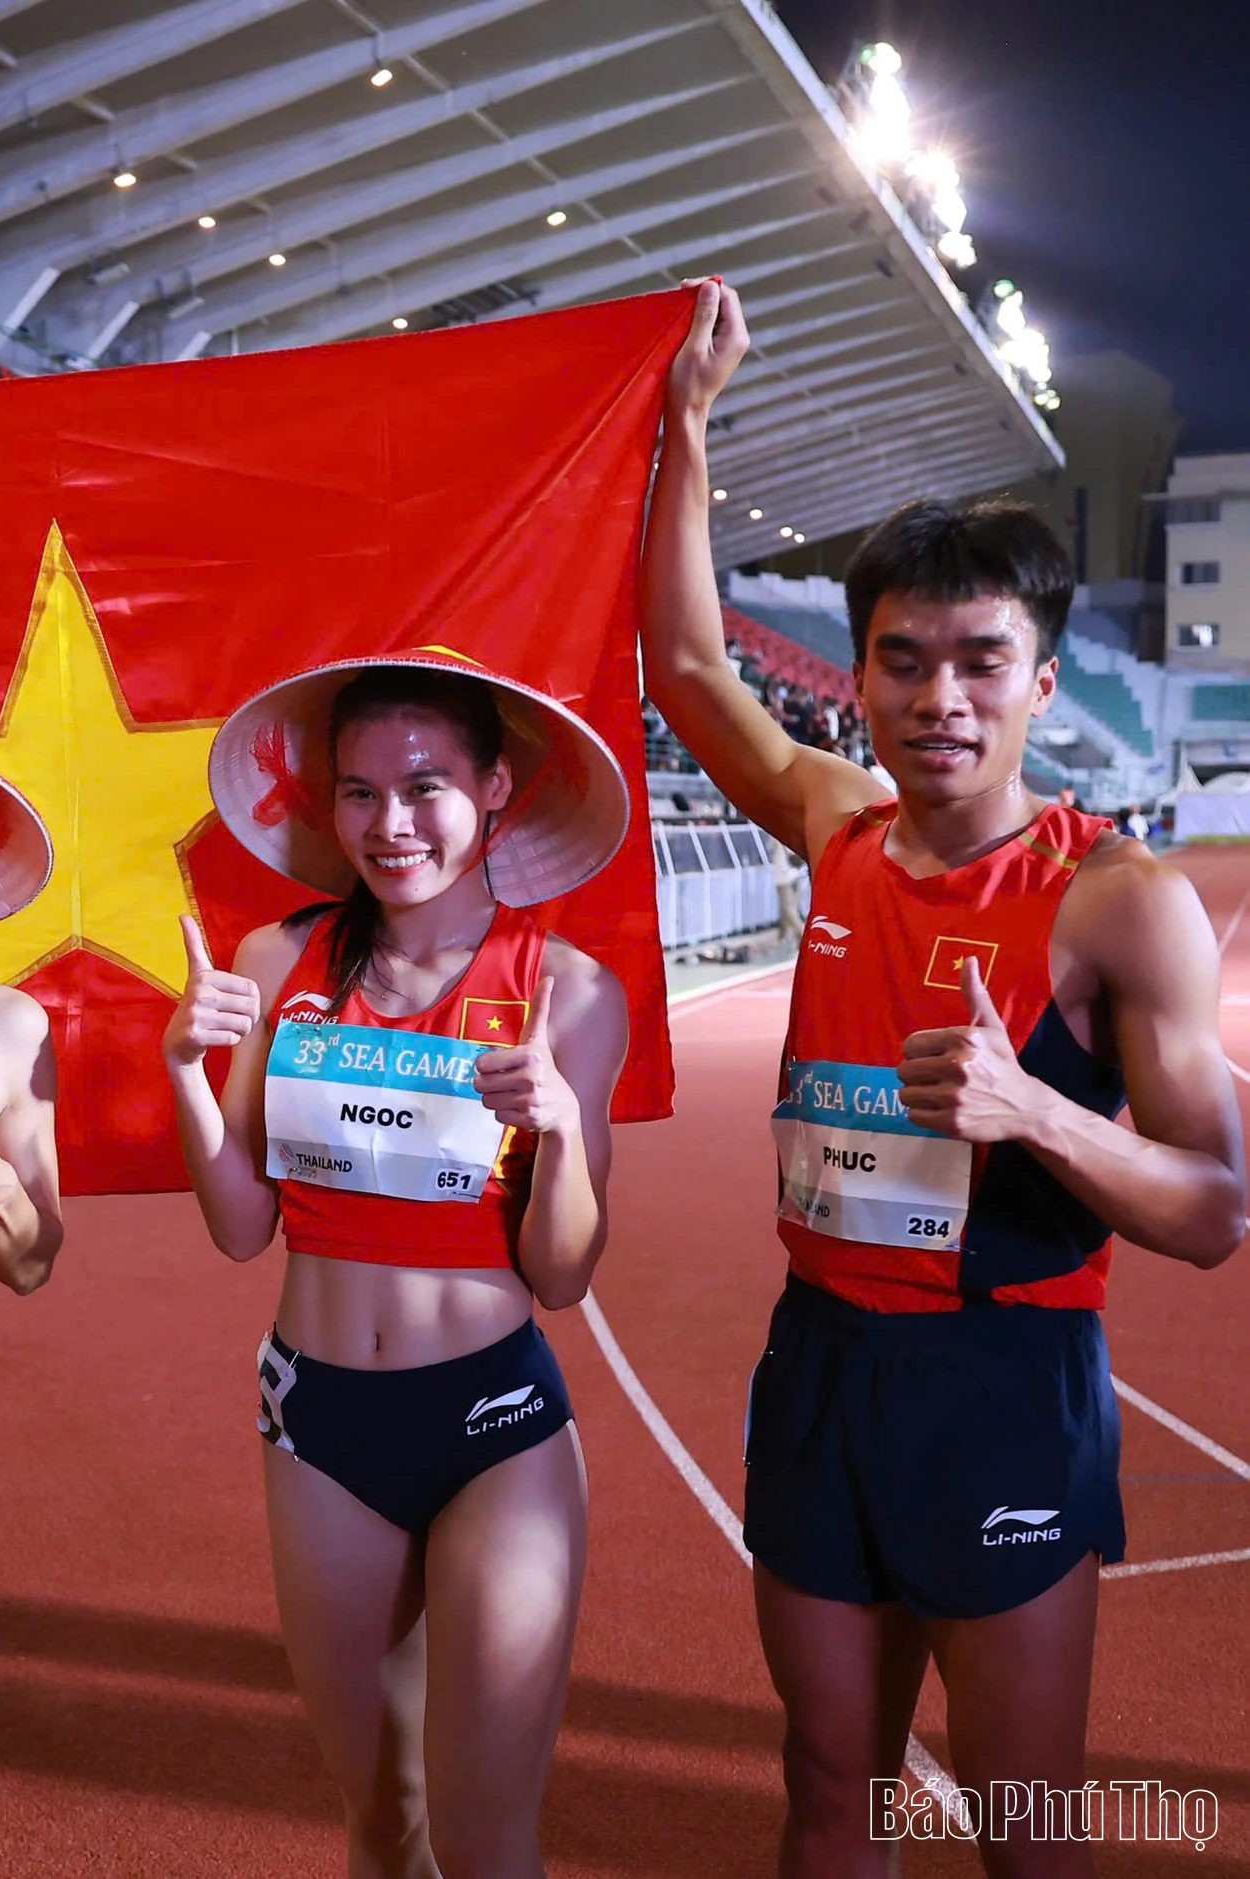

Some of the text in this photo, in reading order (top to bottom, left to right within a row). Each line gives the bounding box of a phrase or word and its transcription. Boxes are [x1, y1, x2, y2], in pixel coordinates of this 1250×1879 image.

[808, 940, 848, 958] I-NING
[338, 1042, 386, 1073] SEA
[395, 1049, 480, 1084] GAME
[814, 1080, 845, 1111] SEA
[339, 1103, 414, 1129] NGOC
[296, 1153, 353, 1173] THAILAND
[823, 1146, 877, 1173] PHUC
[437, 1171, 472, 1190] 651
[908, 1217, 950, 1238] 284
[466, 1396, 545, 1436] LI-NING
[982, 1528, 1062, 1546] LI-NING
